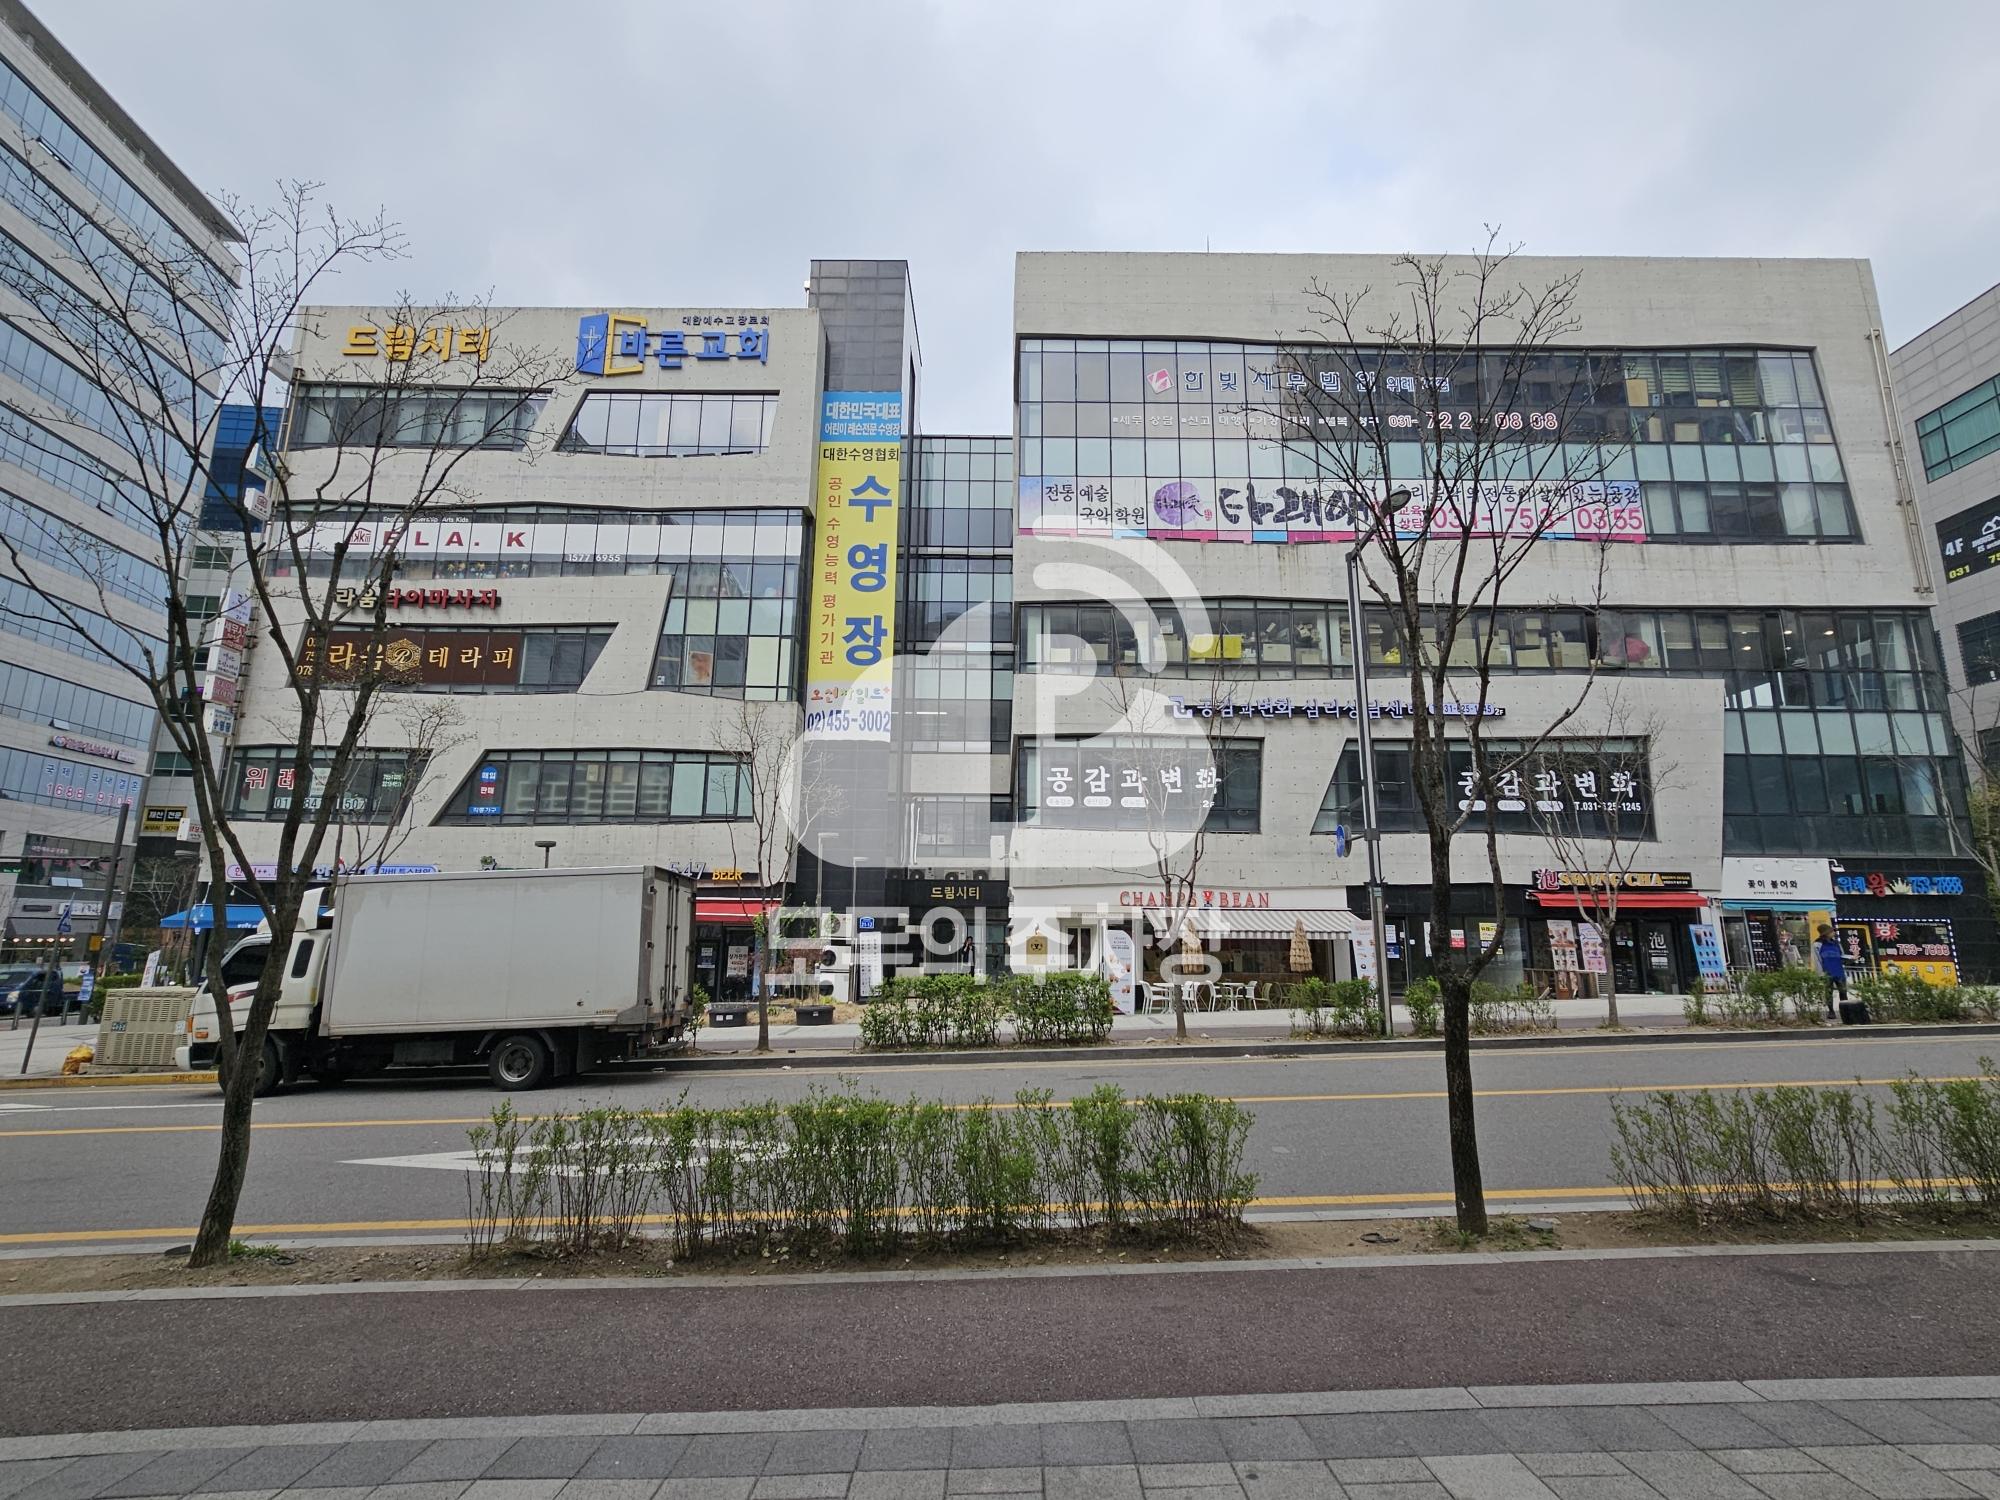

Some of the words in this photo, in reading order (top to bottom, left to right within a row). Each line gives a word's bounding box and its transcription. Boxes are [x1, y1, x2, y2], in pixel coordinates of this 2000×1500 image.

[343, 326, 491, 362] 드림시티
[620, 328, 769, 369] 바른교회
[826, 402, 901, 419] 대한민국대표
[824, 423, 846, 436] 어린이
[878, 423, 900, 436] 수영장
[823, 447, 899, 461] 대한수영협회
[827, 477, 842, 508] 공인
[1045, 484, 1075, 502] 전통
[1079, 484, 1109, 502] 예술
[1080, 507, 1110, 524] 국악
[1114, 507, 1145, 526] 학원
[824, 517, 840, 585] 수영능력
[1945, 538, 1964, 556] 4F
[842, 475, 892, 666] 수영장
[820, 594, 836, 665] 평가기관
[429, 647, 513, 669] 테라피
[807, 709, 890, 732] 02)455-3002
[1046, 766, 1222, 794] 공감과변화
[712, 870, 743, 881] BEER
[1624, 872, 1664, 887] CHA
[931, 886, 980, 900] 드림시티
[1219, 892, 1269, 908] BEAN
